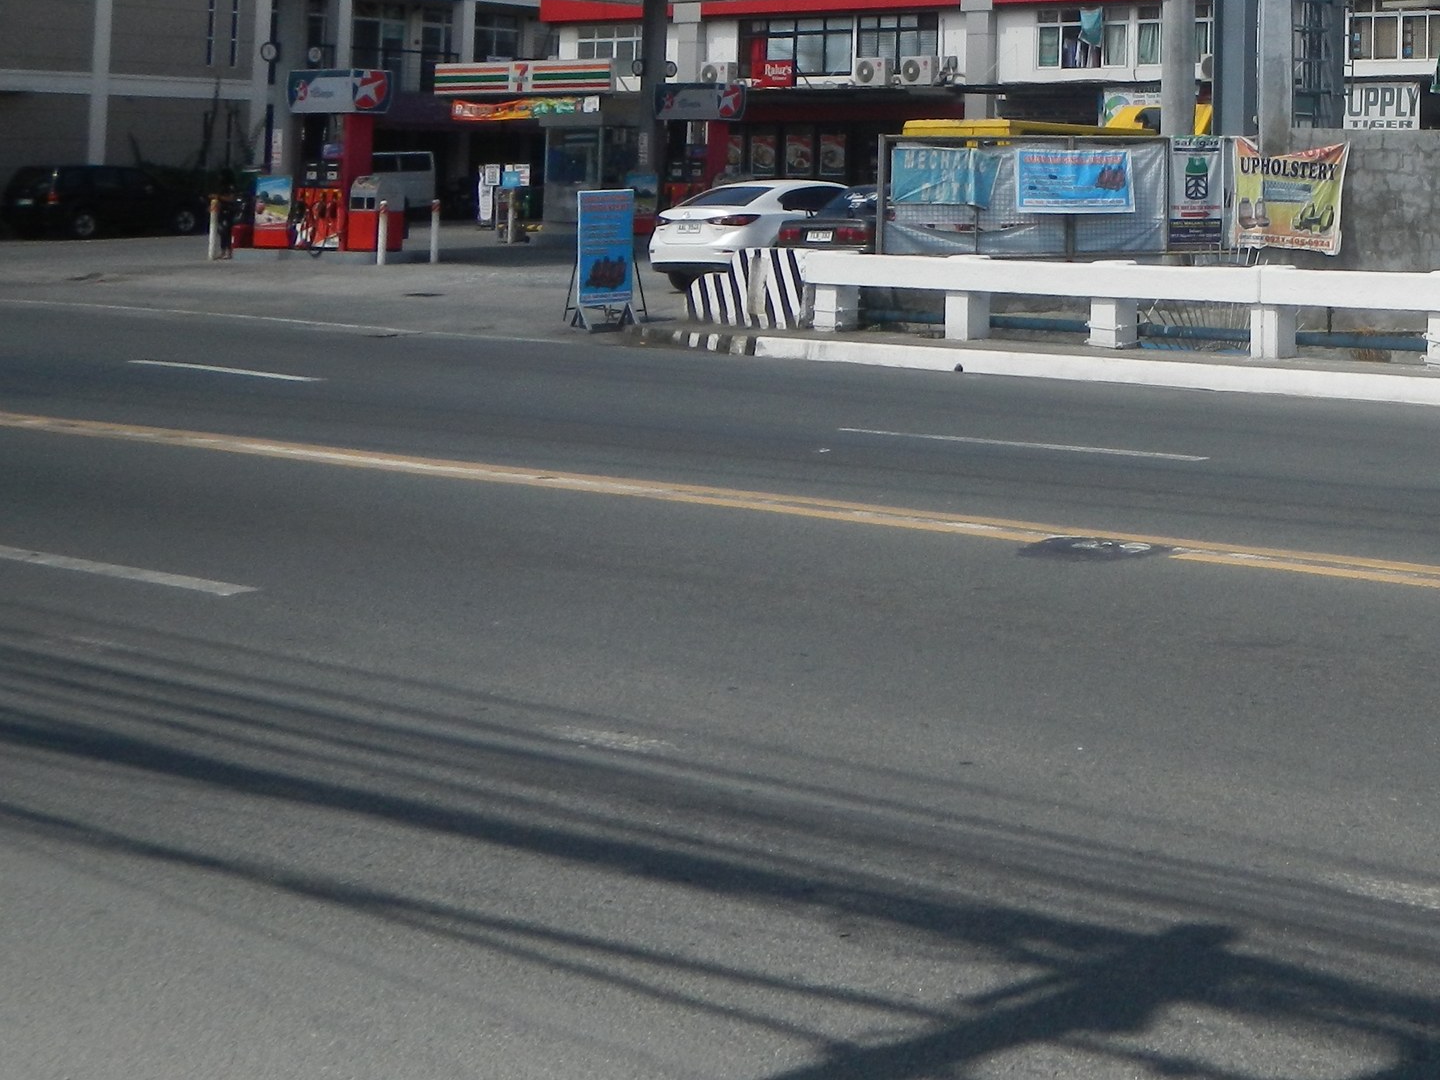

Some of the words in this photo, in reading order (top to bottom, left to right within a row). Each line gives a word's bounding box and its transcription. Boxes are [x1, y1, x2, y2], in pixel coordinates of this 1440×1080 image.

[514, 63, 528, 92] 7
[1343, 86, 1419, 117] UPPLY
[1350, 119, 1414, 129] TIGER
[1240, 156, 1338, 181] UPHOLSTERY
